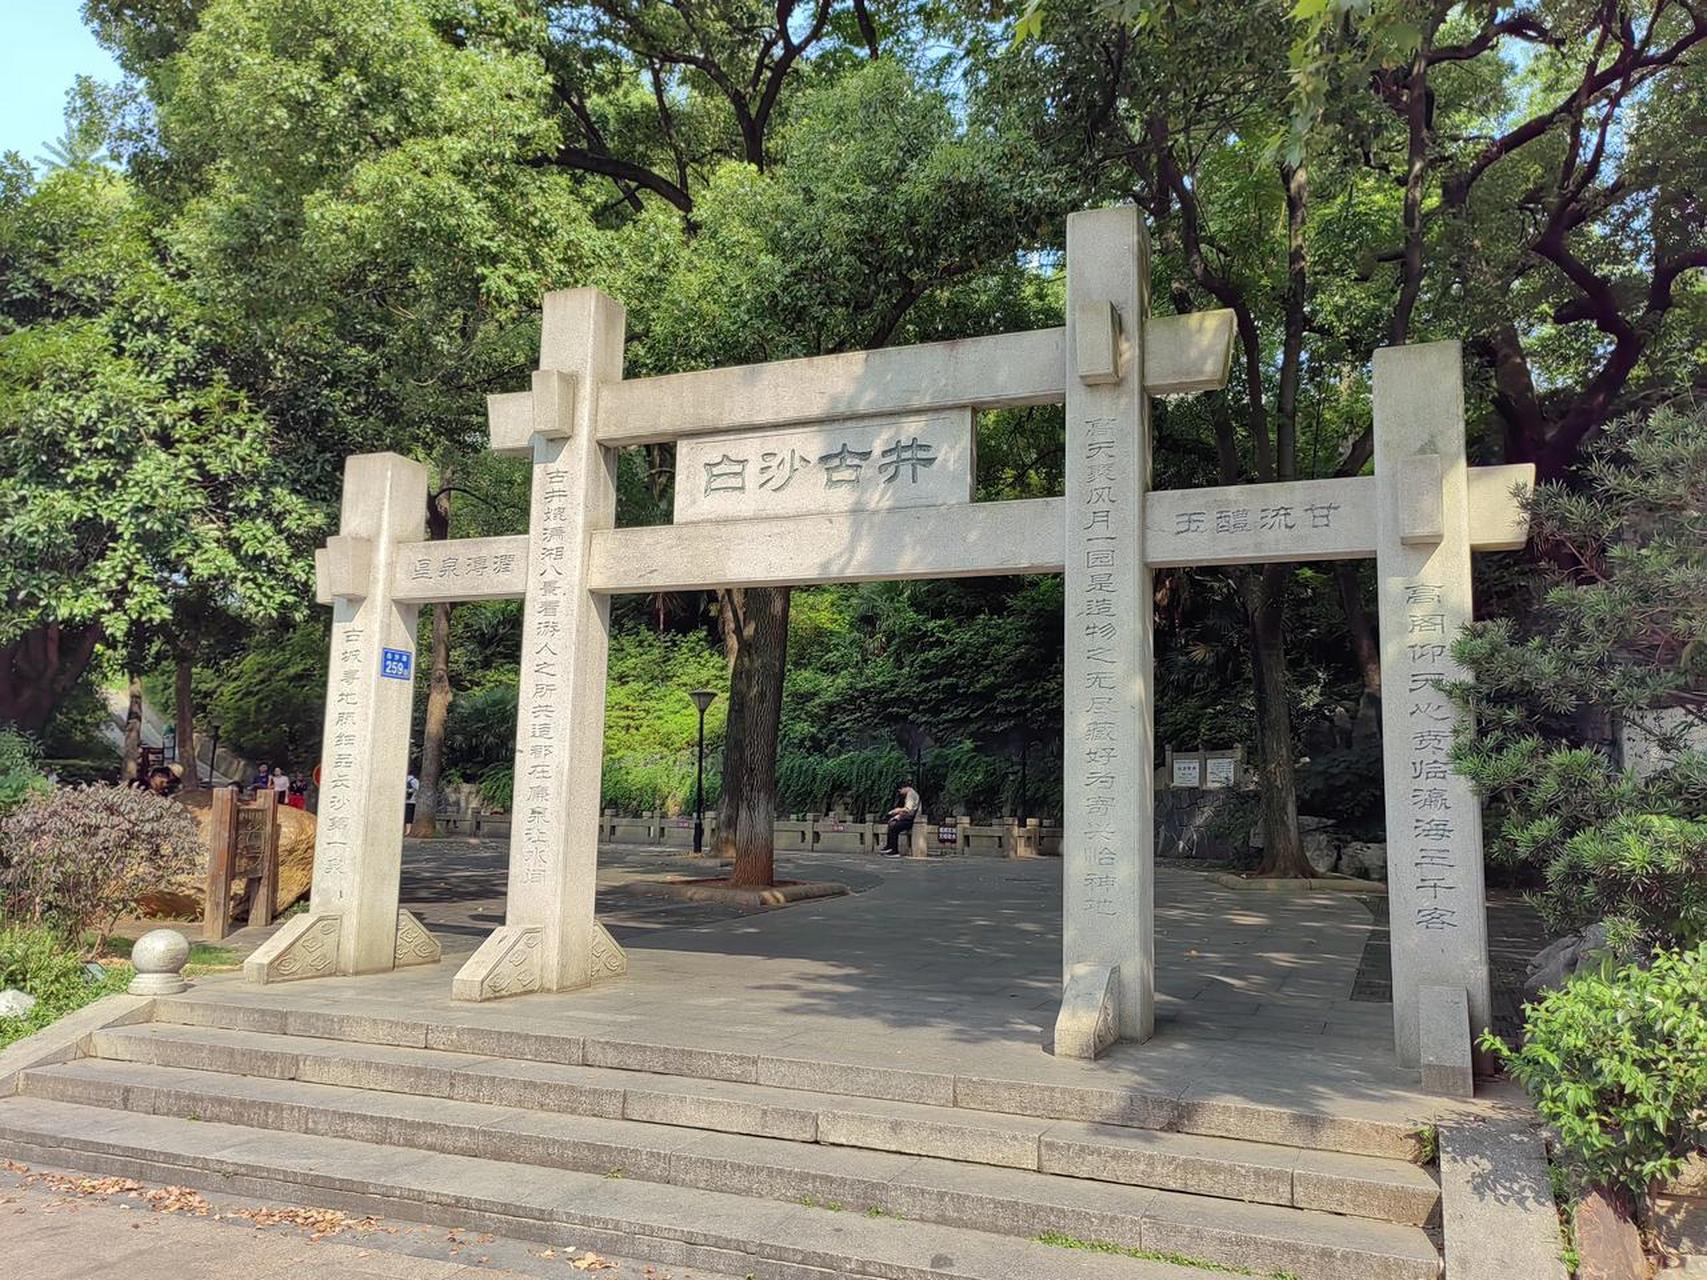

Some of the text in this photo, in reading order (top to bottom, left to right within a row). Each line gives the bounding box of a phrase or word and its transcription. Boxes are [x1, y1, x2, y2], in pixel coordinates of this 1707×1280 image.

[703, 437, 938, 497] 白沙古井
[1174, 502, 1341, 535] 玉醴流甘
